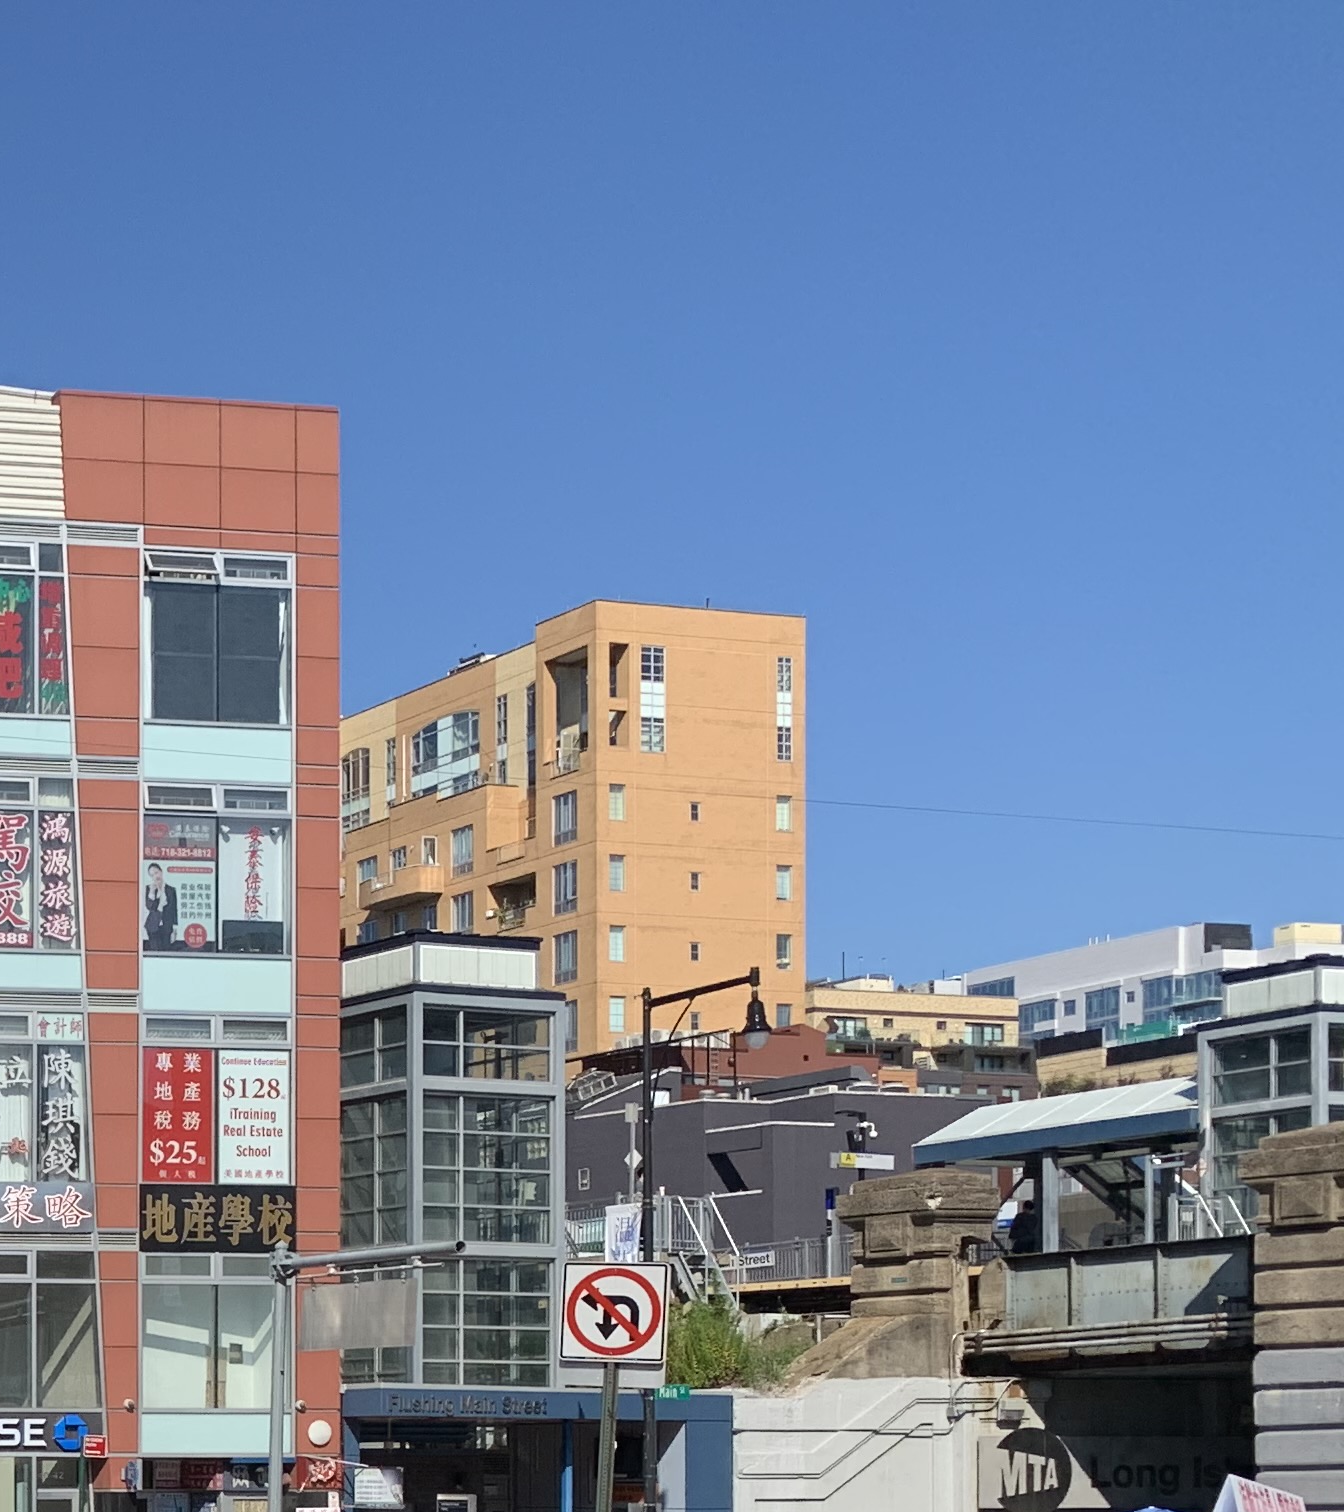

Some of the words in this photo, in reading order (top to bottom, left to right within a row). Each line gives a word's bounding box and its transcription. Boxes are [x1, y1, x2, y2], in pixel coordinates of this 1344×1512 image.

[223, 1076, 281, 1100] $128
[230, 1108, 277, 1123] iTraining
[223, 1125, 246, 1137] Real
[250, 1125, 283, 1137] Estate
[150, 1138, 198, 1166] $25
[236, 1145, 271, 1157] School
[142, 1191, 294, 1246] 地產學校
[659, 1386, 678, 1398] Main
[388, 1393, 454, 1416] Flushing
[460, 1394, 497, 1415] Main
[501, 1396, 548, 1415] Street
[1000, 1450, 1059, 1498] MTA
[1091, 1455, 1180, 1493] Long
